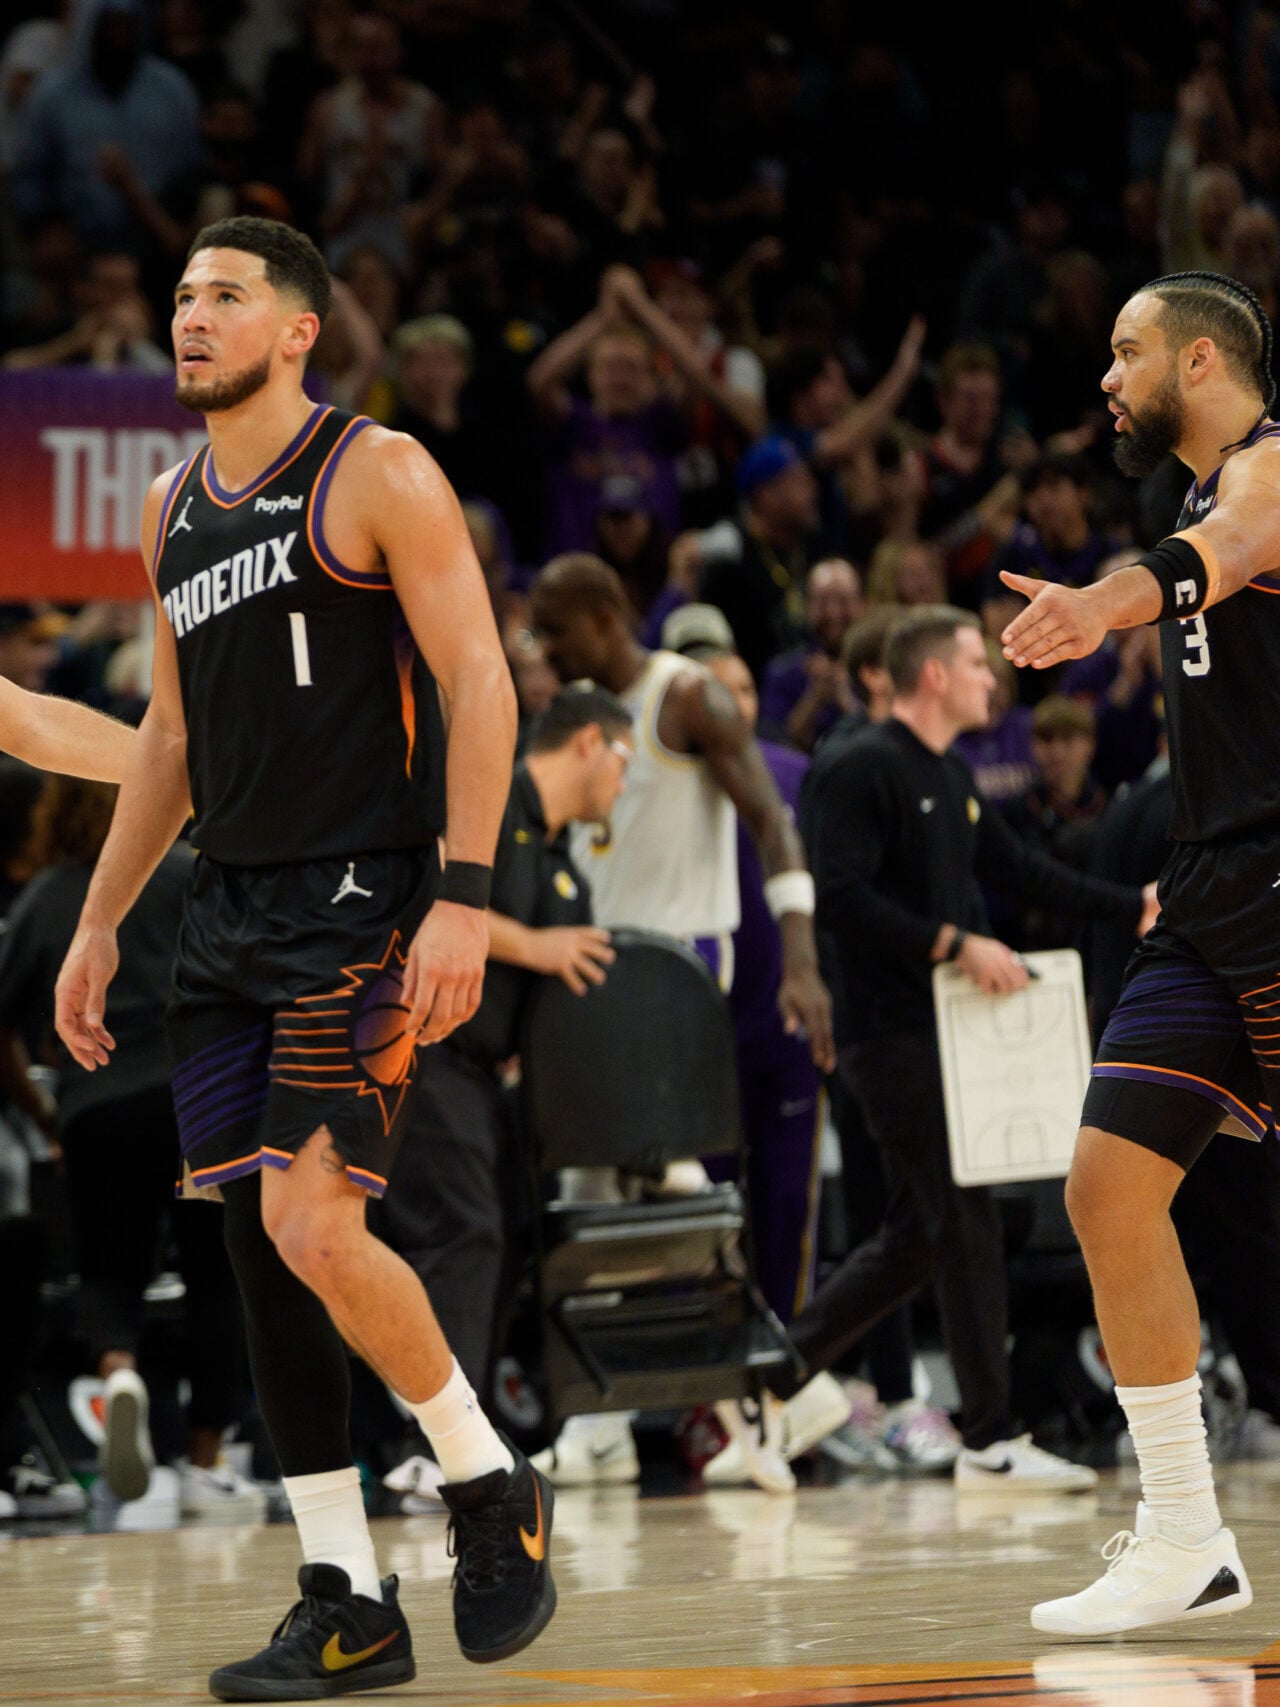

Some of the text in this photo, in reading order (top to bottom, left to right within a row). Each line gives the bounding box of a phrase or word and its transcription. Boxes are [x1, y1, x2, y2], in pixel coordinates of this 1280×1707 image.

[40, 428, 210, 551] TH
[254, 495, 304, 515] PayPal
[288, 612, 313, 687] 1
[1179, 612, 1211, 677] 3
